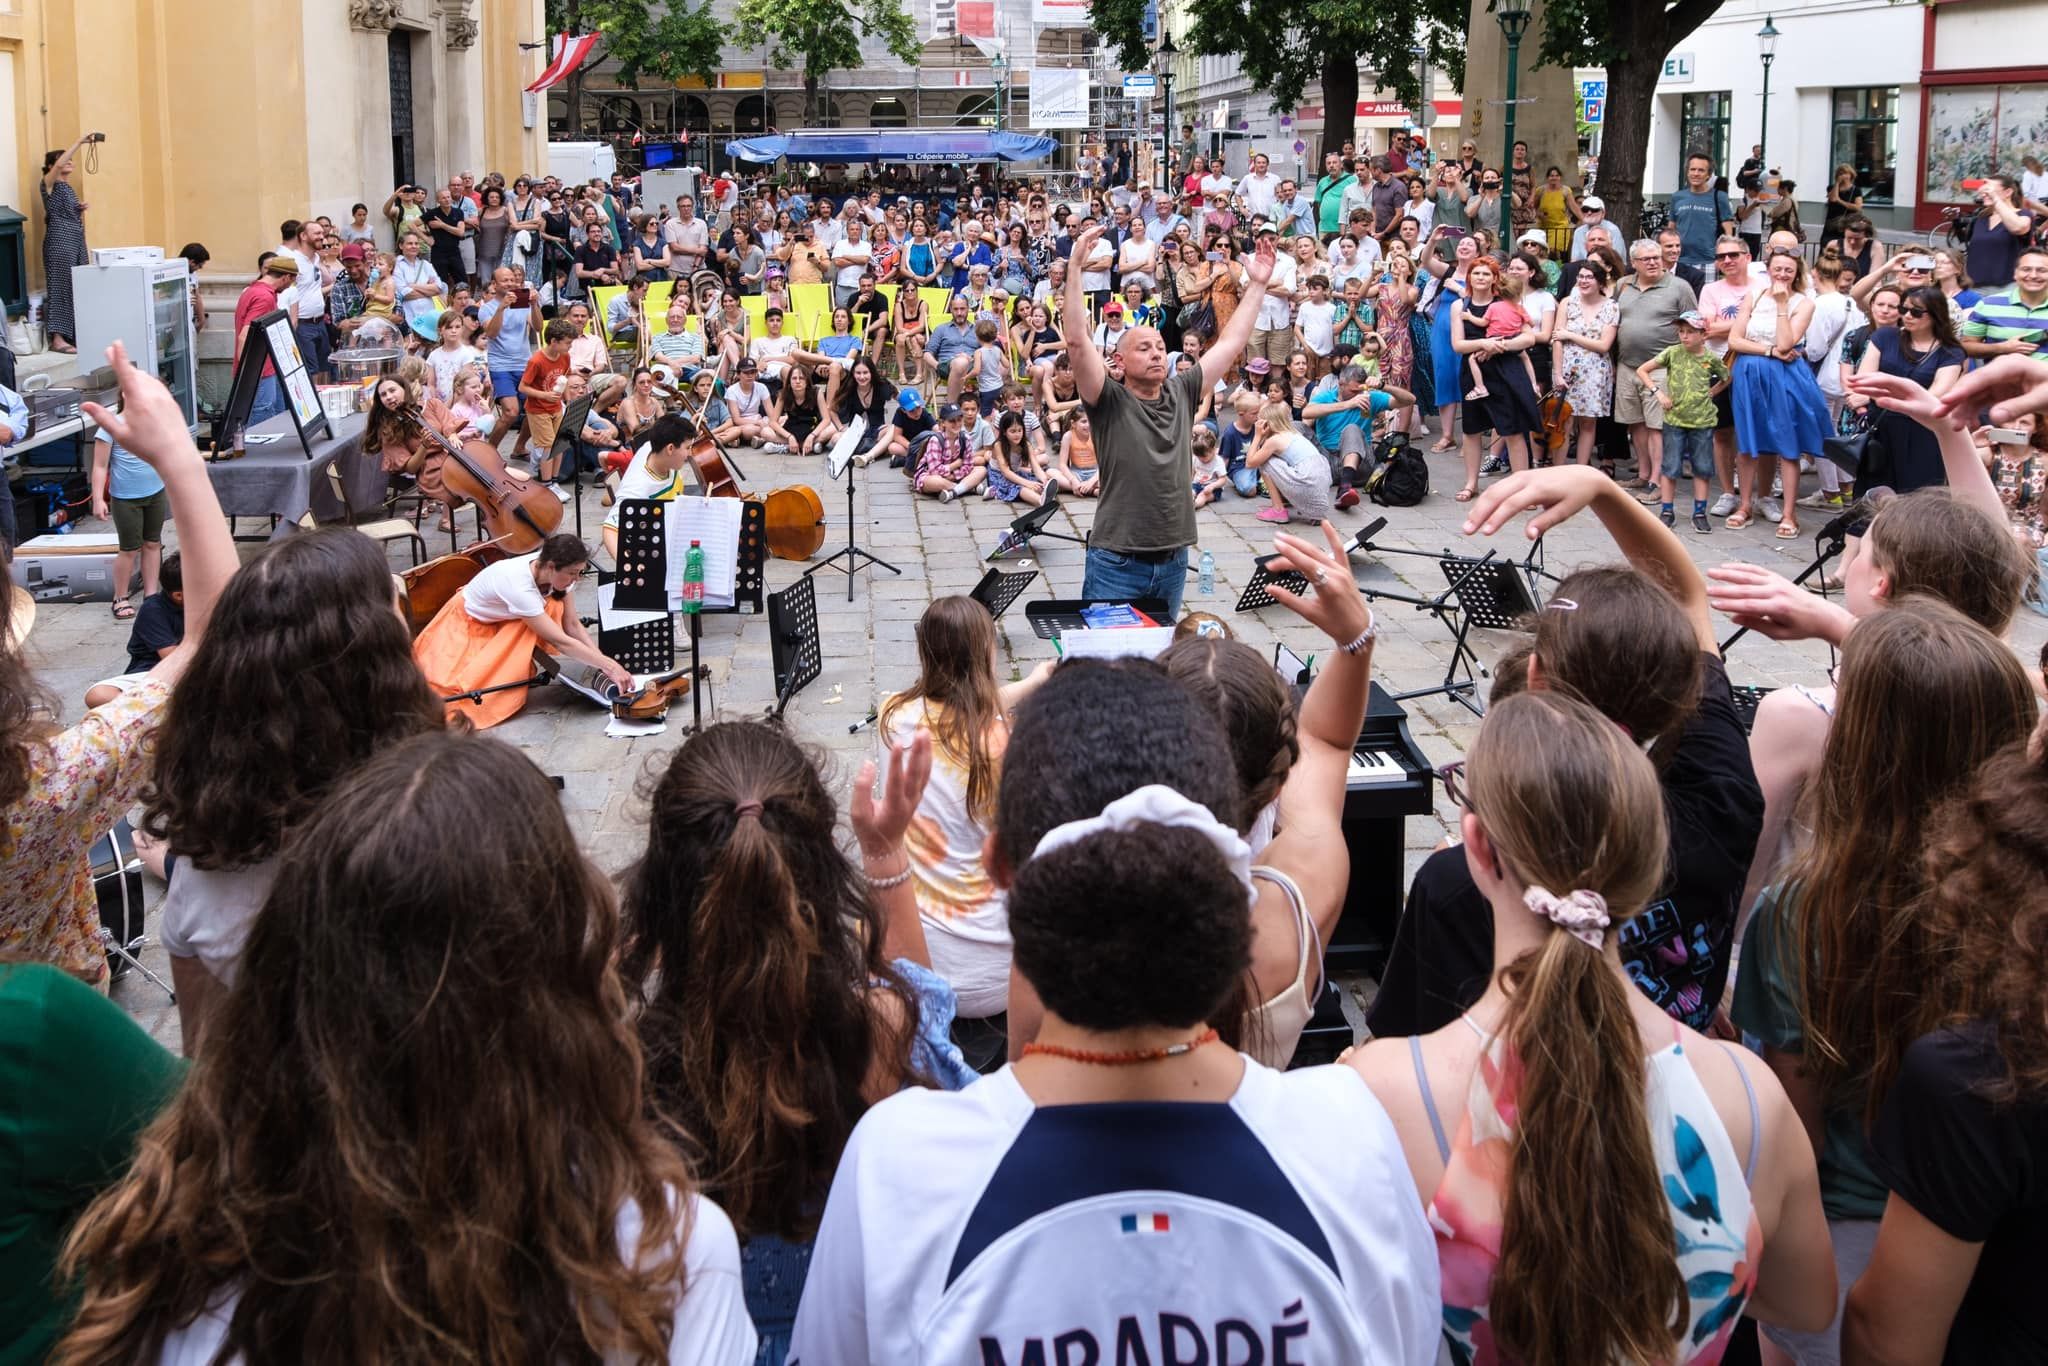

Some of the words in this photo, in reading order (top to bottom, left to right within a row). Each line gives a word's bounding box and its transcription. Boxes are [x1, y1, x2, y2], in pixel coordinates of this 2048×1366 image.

[906, 152, 914, 160] la
[915, 152, 944, 161] Crêperie
[945, 152, 969, 160] mobile
